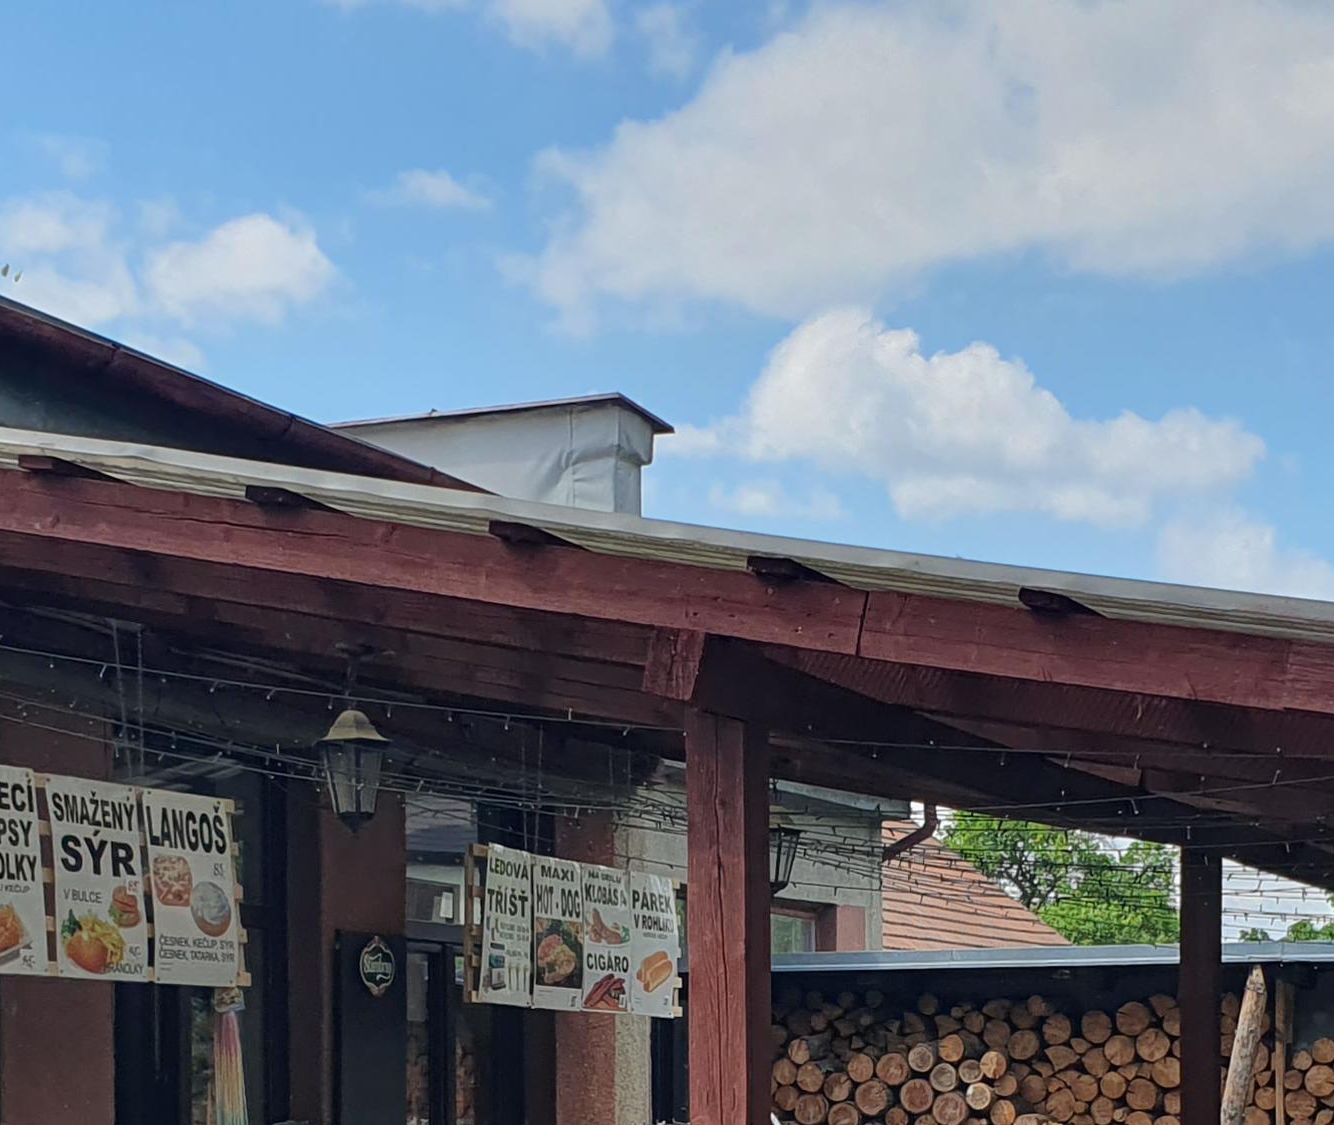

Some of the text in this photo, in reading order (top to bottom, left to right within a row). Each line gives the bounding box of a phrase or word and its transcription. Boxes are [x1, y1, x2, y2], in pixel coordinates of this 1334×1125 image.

[51, 791, 136, 832] SMAŽENÝ
[145, 804, 227, 855] LANGOŠ
[60, 829, 137, 878] SÝR
[540, 865, 575, 882] MAXI
[63, 888, 103, 904] V BULCE
[487, 885, 529, 918] TŘÍŠŤ
[536, 883, 554, 915] HOT
[560, 888, 581, 919] DOG
[584, 884, 627, 907] KLOBÁSA
[631, 886, 673, 915] PÁREK
[633, 913, 640, 929] V
[586, 950, 629, 973] CIGÁRO
